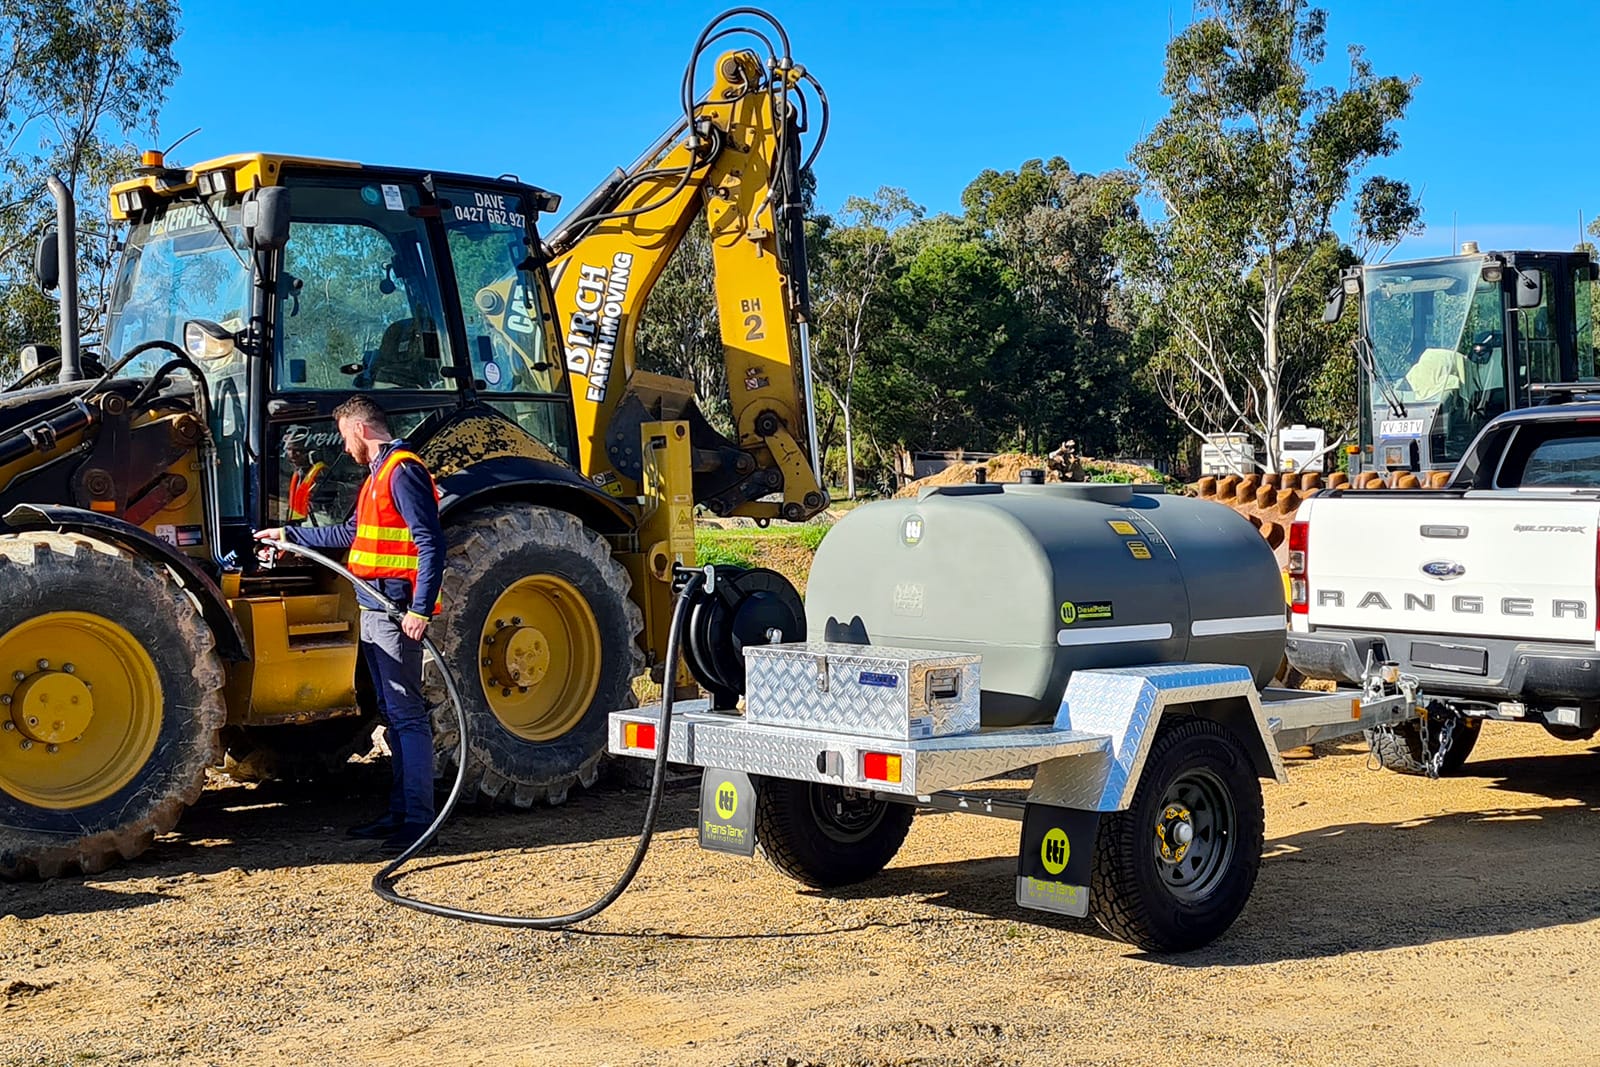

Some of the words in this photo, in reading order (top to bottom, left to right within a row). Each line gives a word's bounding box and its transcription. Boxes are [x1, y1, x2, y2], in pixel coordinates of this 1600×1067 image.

[474, 192, 506, 210] DAVE
[454, 206, 484, 222] 0427
[487, 210, 508, 225] 662
[509, 213, 526, 229] 927
[565, 262, 608, 376] BIRCH
[741, 298, 761, 313] BH
[586, 252, 633, 403] EARTHMOVING
[744, 314, 765, 341] 2
[1317, 589, 1587, 620] RANGER
